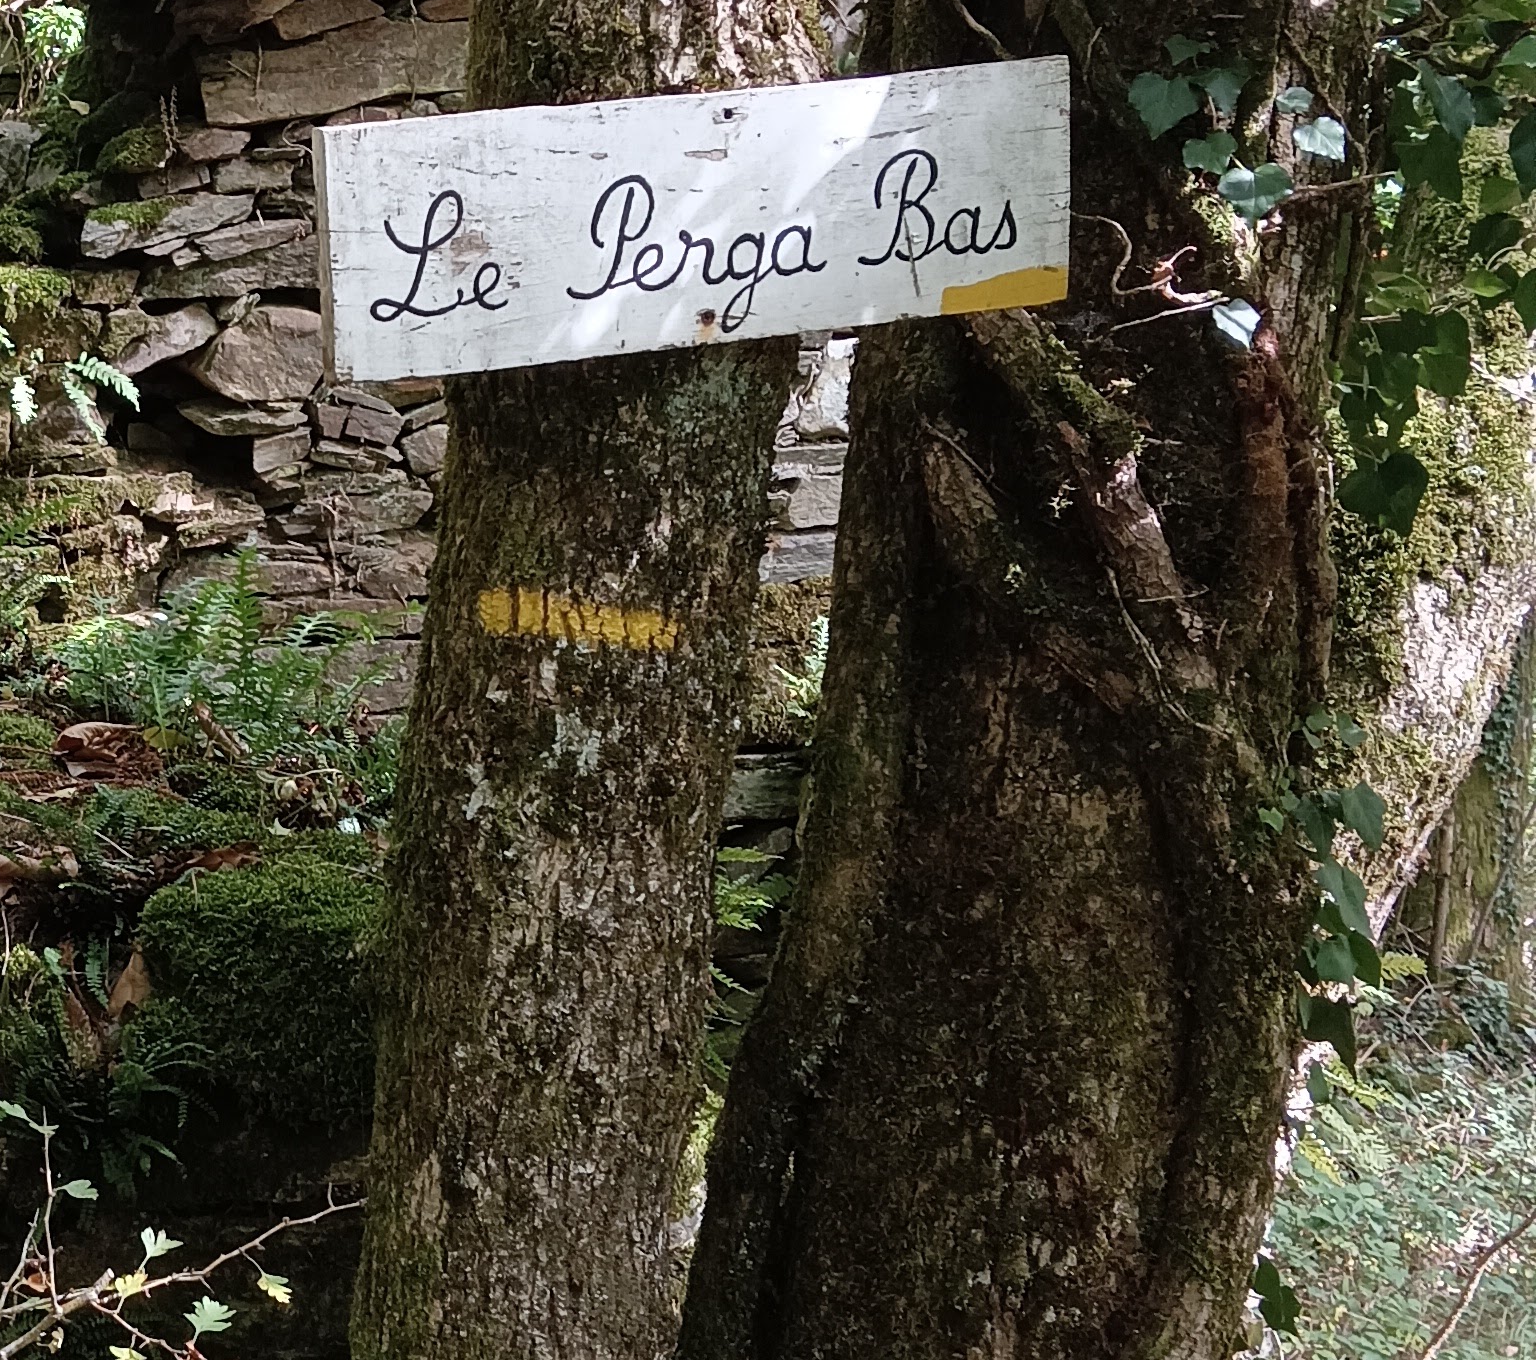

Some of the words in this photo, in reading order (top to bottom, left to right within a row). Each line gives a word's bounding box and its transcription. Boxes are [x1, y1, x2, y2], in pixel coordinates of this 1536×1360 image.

[370, 189, 508, 322] Le
[567, 174, 827, 333] Perga
[858, 149, 1018, 266] Bas
